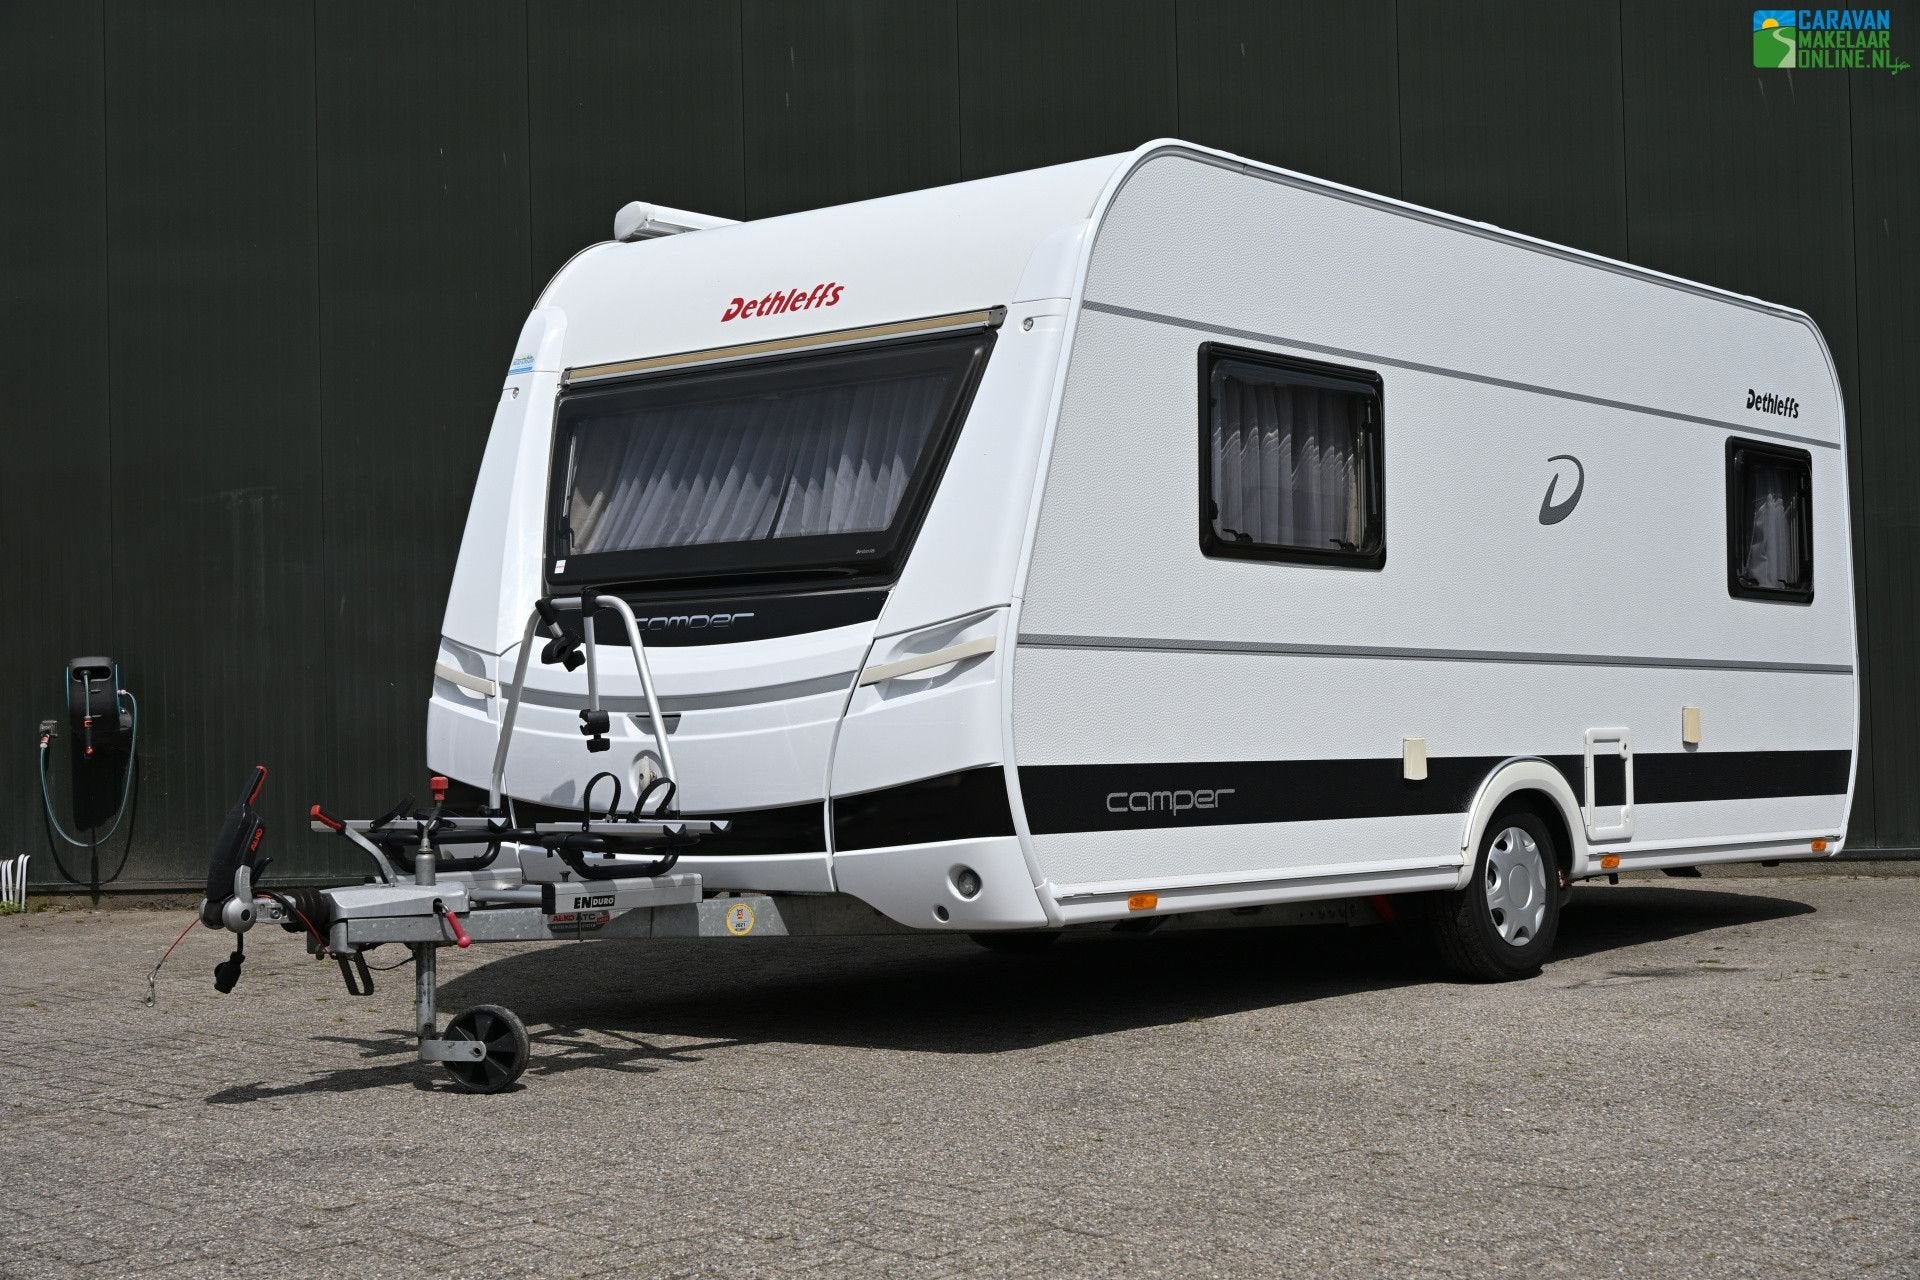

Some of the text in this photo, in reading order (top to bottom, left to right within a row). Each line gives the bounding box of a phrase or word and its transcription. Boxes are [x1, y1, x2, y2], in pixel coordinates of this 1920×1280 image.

[721, 282, 845, 322] Dethleffs
[1746, 388, 1799, 419] Dethleffs
[1106, 788, 1236, 816] camper
